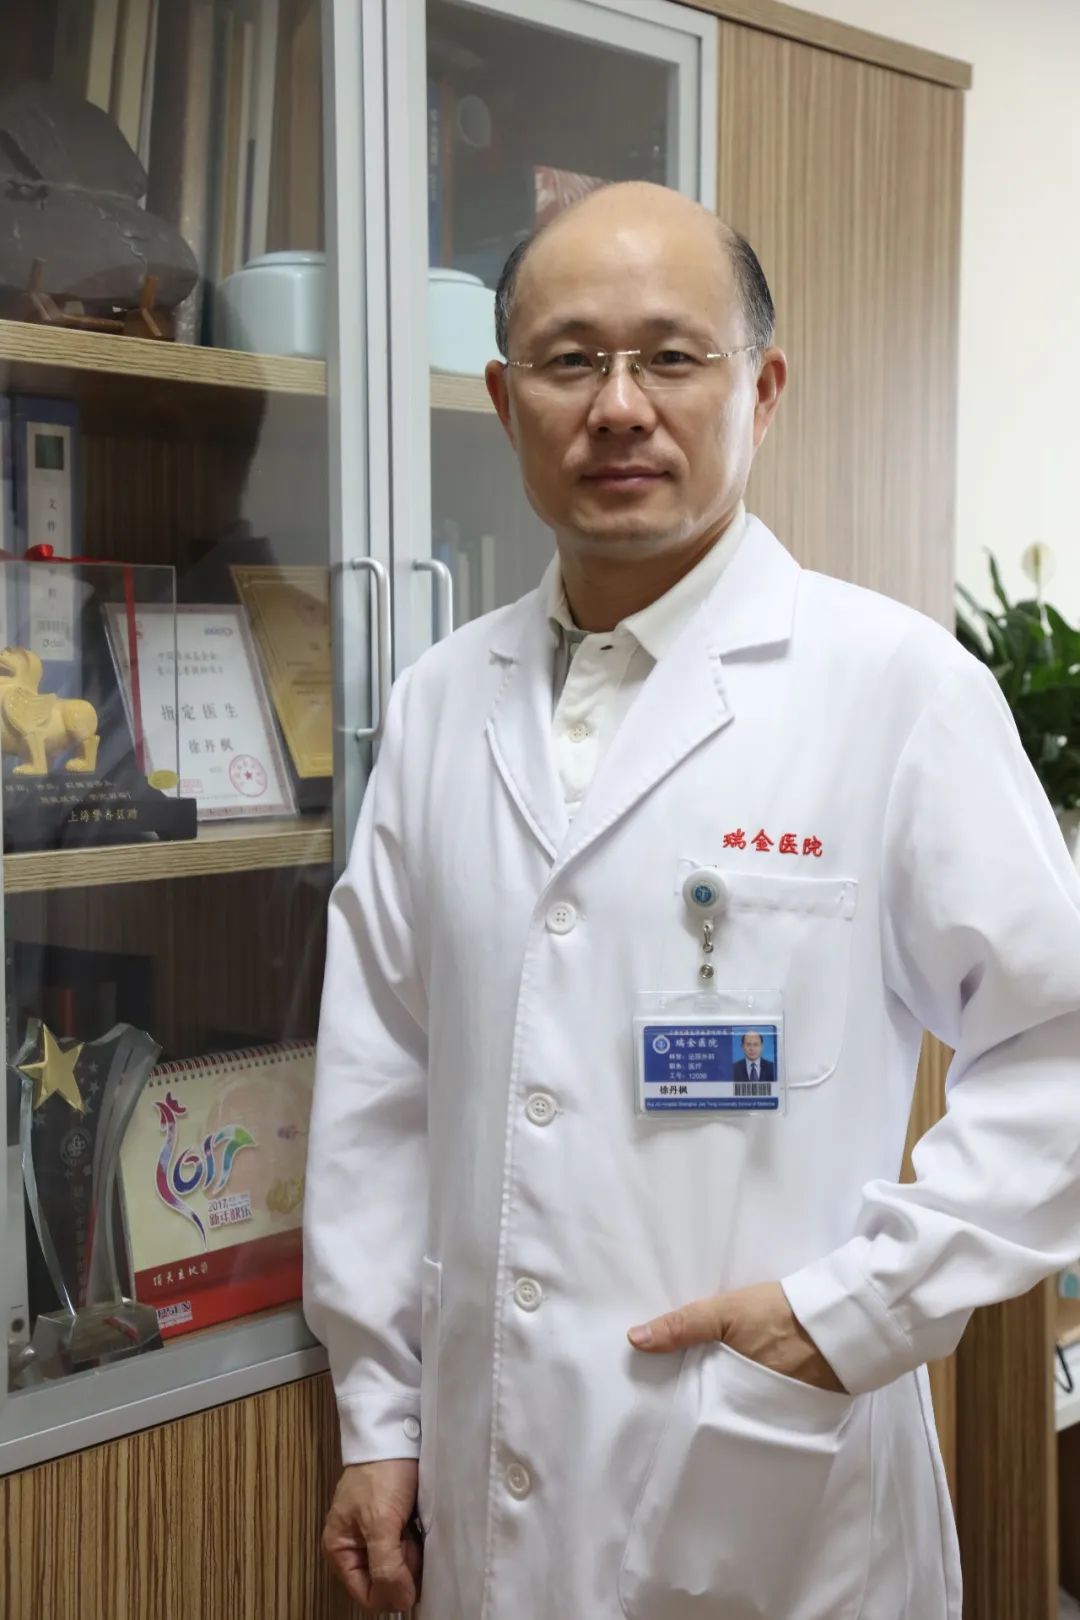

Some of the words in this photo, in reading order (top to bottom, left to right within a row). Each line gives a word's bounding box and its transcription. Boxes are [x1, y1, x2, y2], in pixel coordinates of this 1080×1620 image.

[161, 702, 239, 721] 指定医生
[722, 828, 823, 857] 瑞金医院
[675, 1037, 719, 1048] 瑞金医院
[660, 1085, 688, 1095] 徐丹枫
